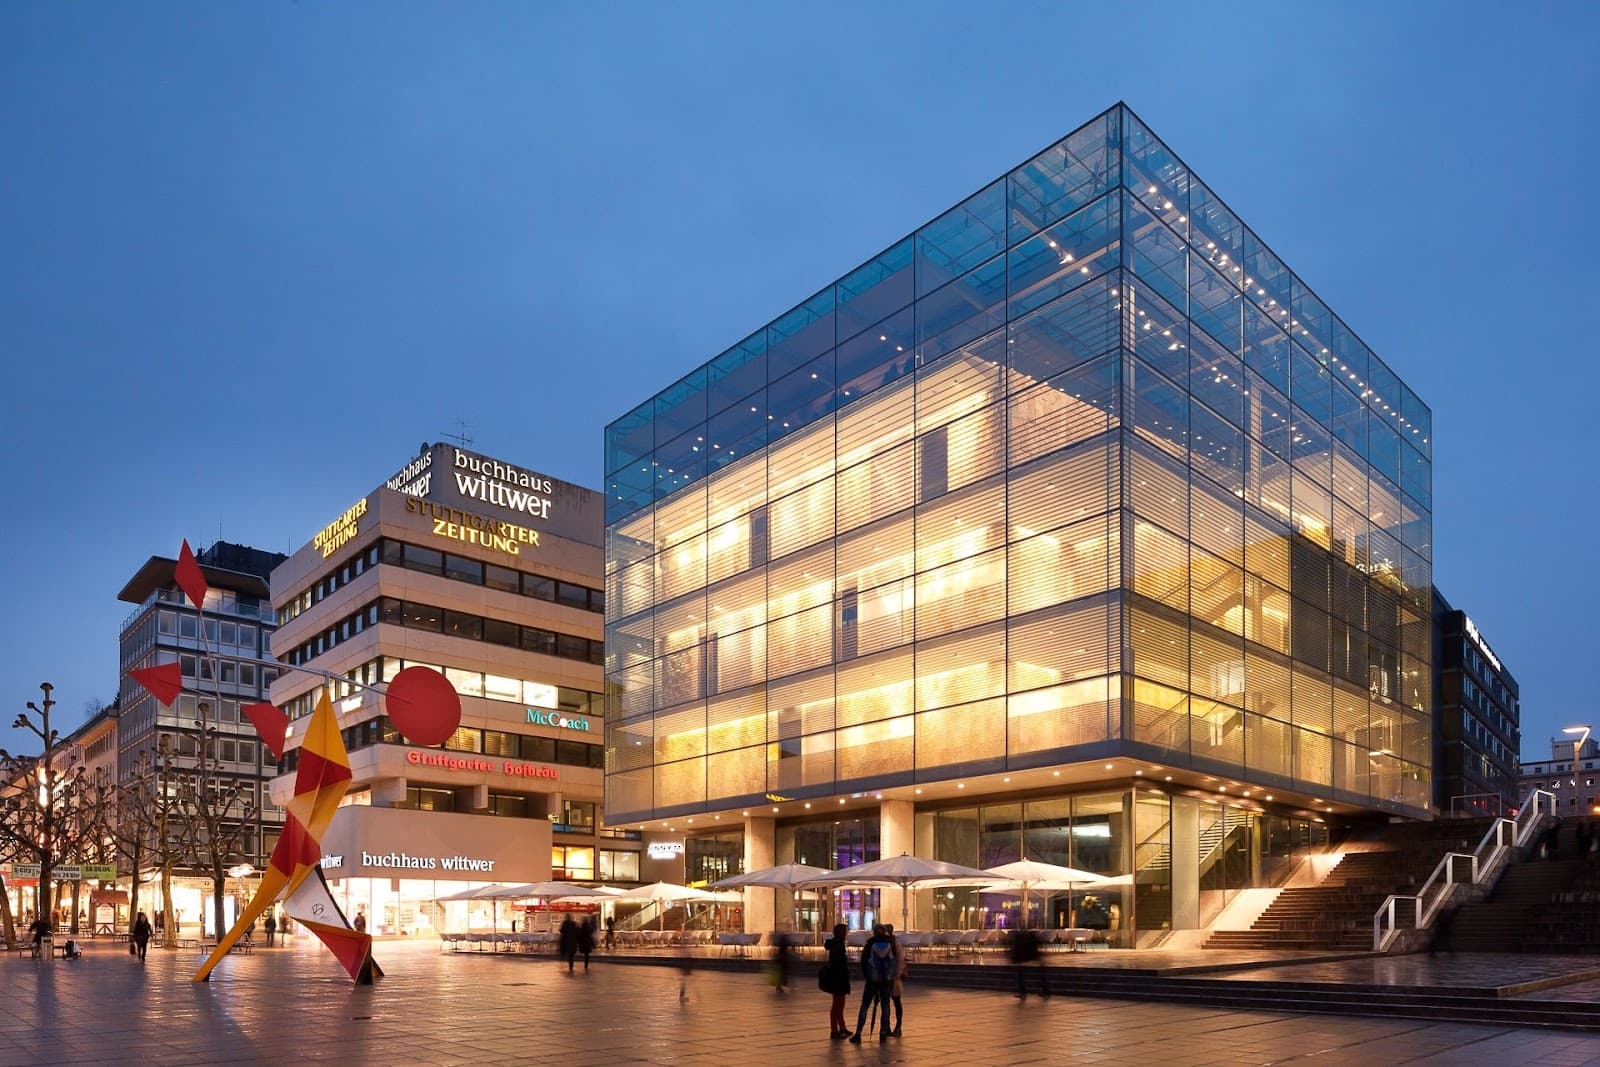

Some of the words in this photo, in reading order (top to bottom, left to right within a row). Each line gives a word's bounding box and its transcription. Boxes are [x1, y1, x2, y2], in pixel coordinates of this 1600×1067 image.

[455, 448, 552, 494] buchhaus
[454, 472, 551, 520] wittwer
[314, 498, 368, 551] STUTTGARTER
[406, 497, 540, 546] STUTTGARTER
[433, 519, 520, 555] ZEITUNG
[323, 522, 358, 559] ZEITUNG
[526, 708, 589, 731] McCoach
[407, 750, 494, 773] Stuttgarter
[504, 761, 559, 780] Hofbräu
[362, 851, 436, 869] buchhaus
[441, 855, 495, 873] wittwer
